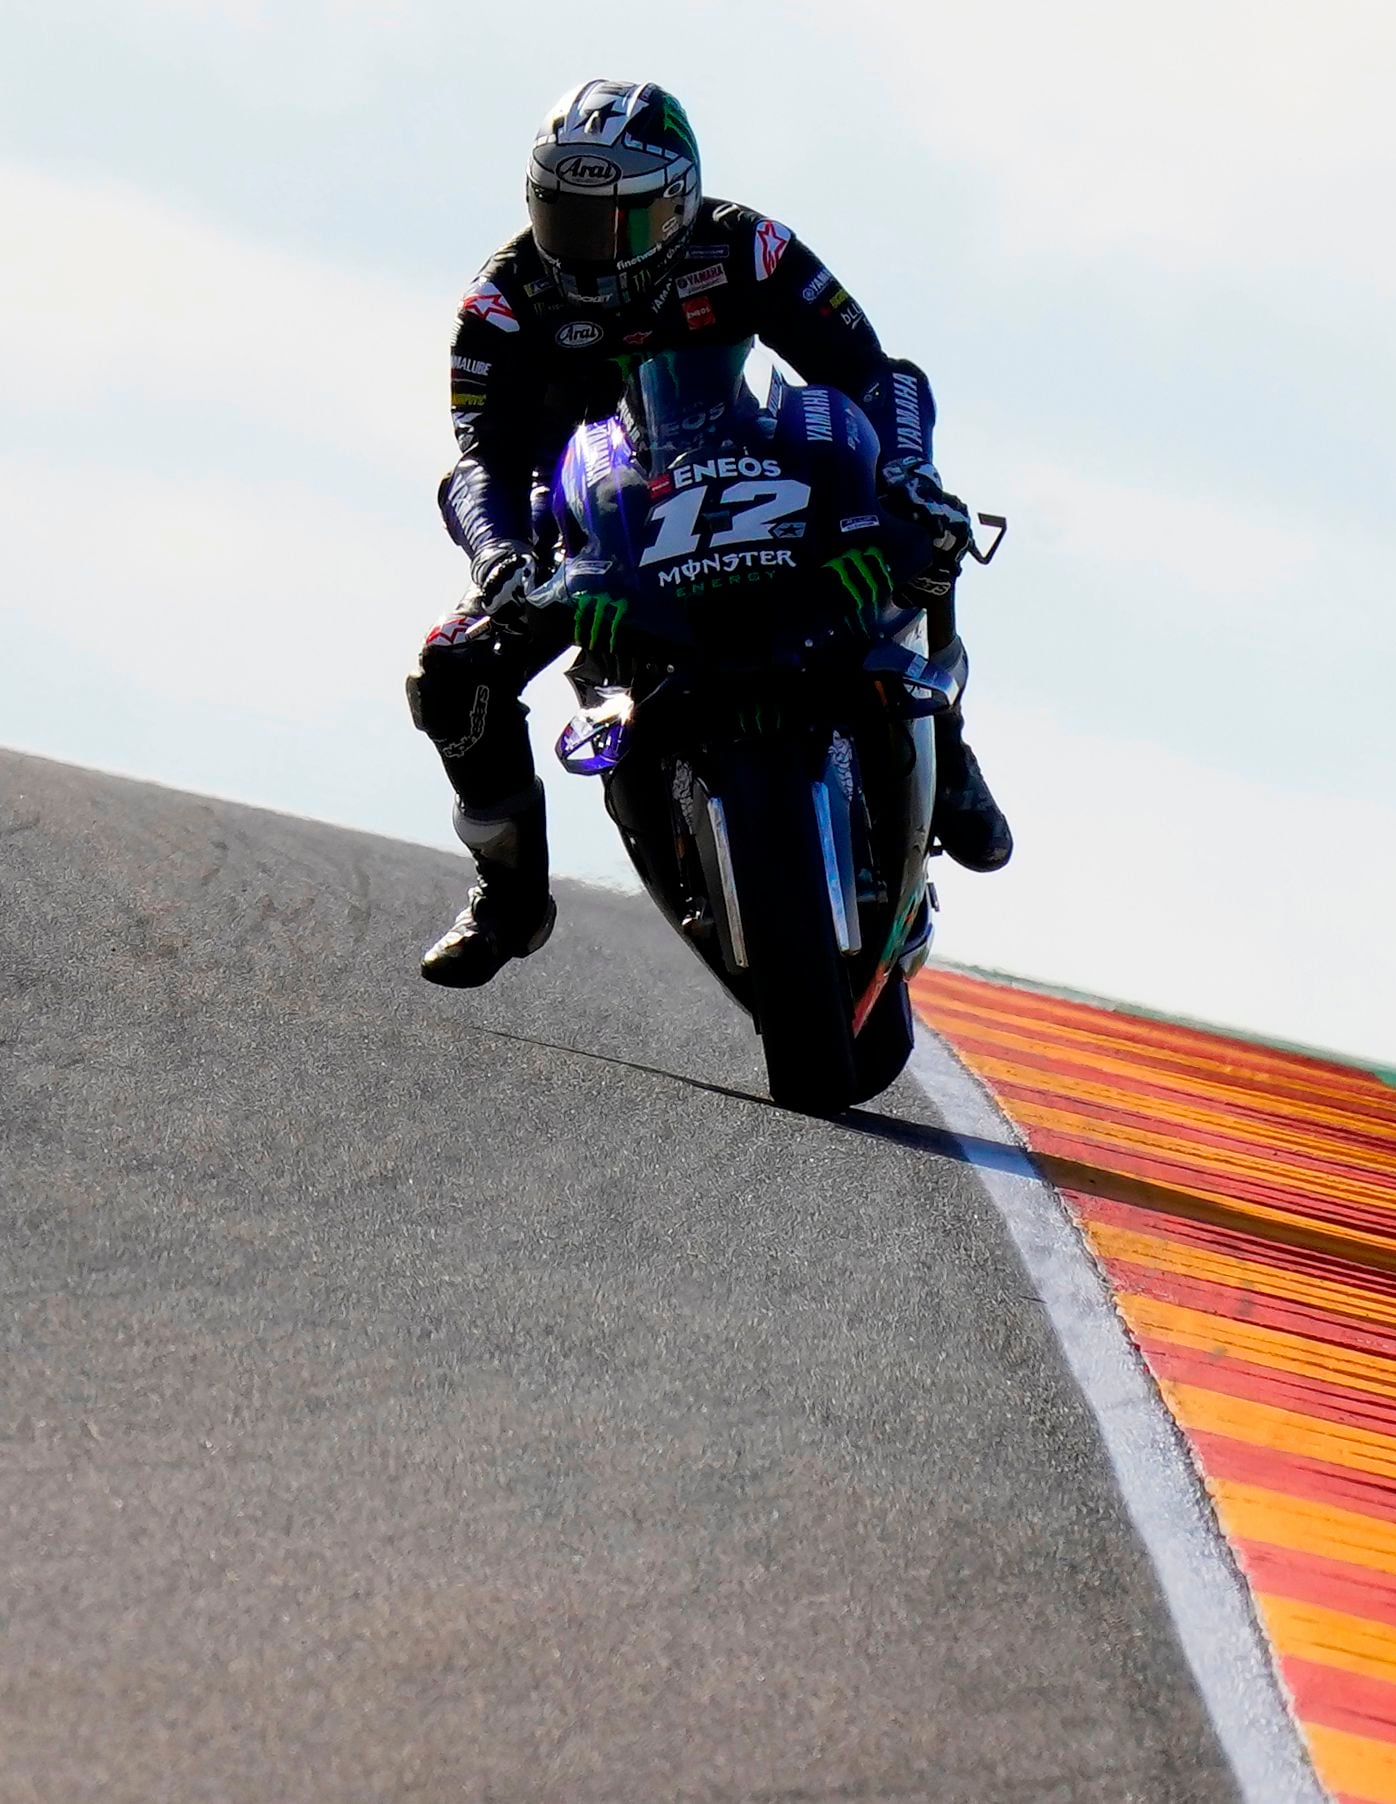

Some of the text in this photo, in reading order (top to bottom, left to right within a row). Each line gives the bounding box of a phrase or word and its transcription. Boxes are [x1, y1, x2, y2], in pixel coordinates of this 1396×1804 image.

[561, 157, 614, 178] Arai
[686, 266, 723, 287] YAMAHA
[561, 325, 598, 343] Arai
[802, 389, 833, 442] YAMAHA
[892, 373, 924, 453] YAMAHA
[673, 457, 782, 489] ENEOS
[638, 479, 812, 568] 12
[657, 550, 797, 588] MONSTER
[675, 570, 776, 598] ENERGY
